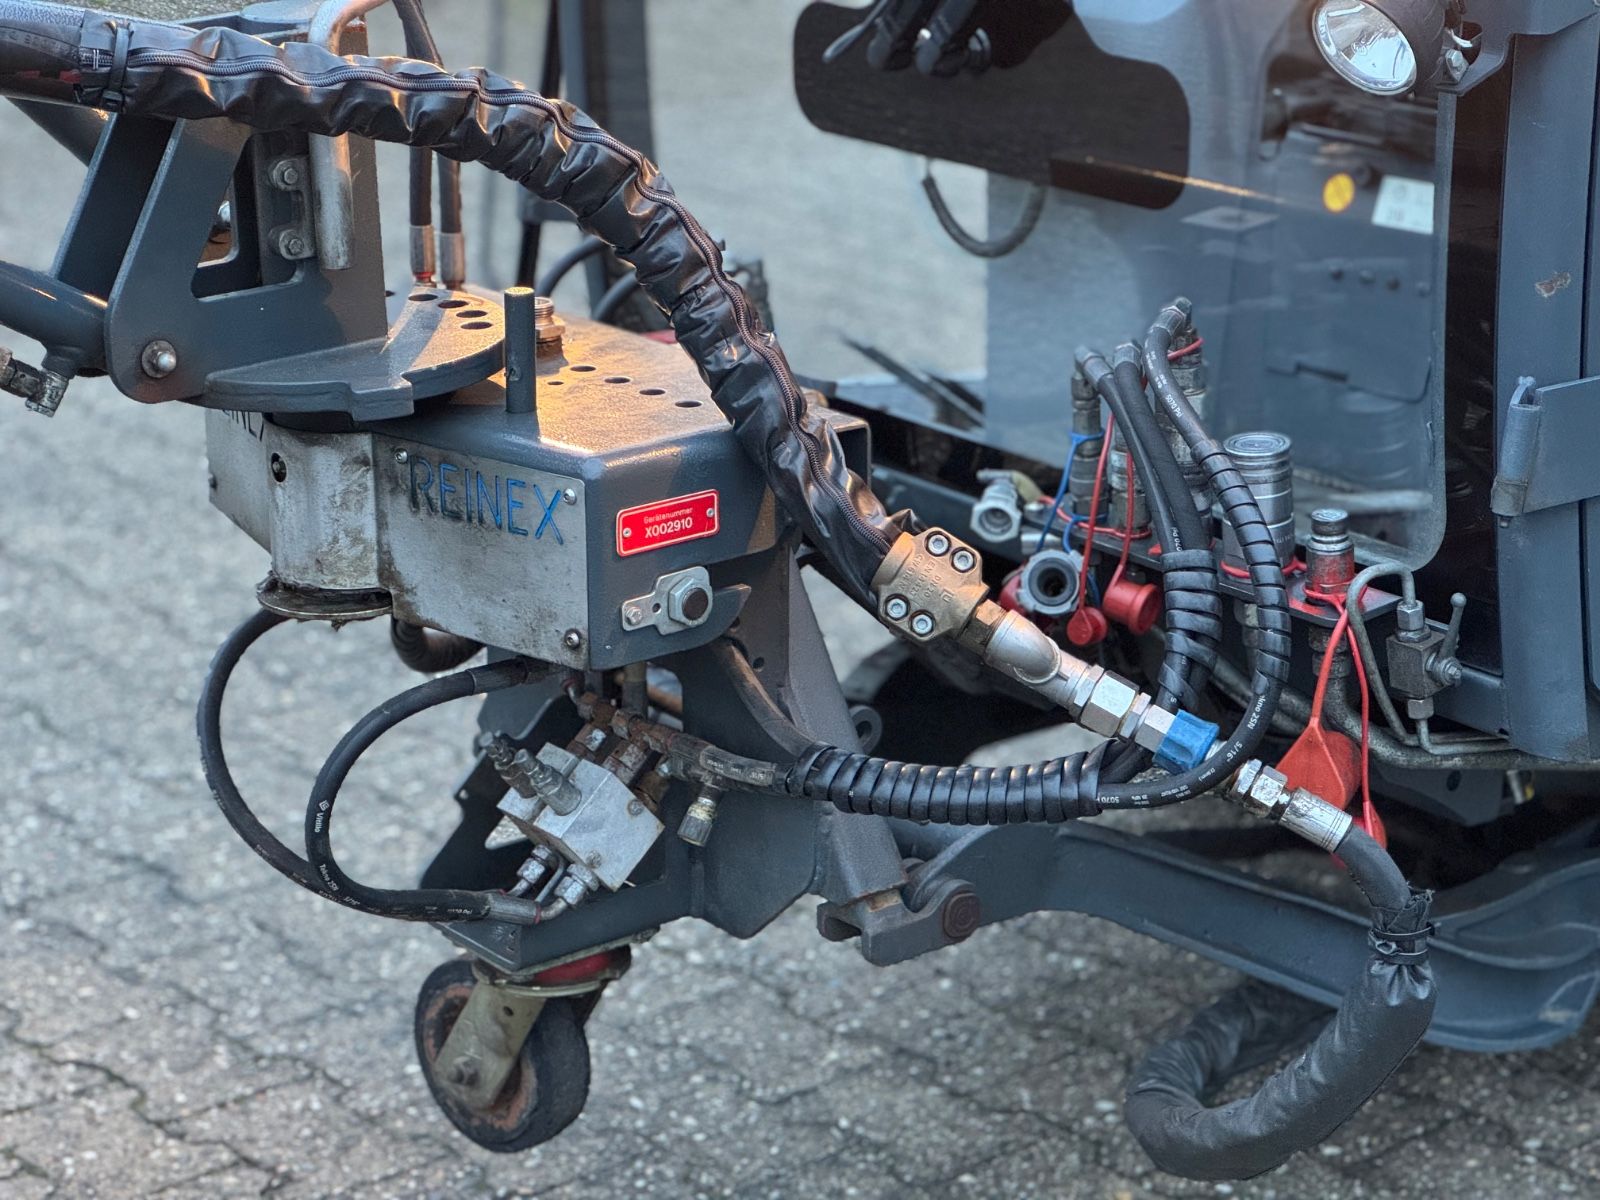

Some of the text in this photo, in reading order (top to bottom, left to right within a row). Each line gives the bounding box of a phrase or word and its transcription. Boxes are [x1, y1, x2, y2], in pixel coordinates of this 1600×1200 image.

[409, 454, 564, 545] REINEX
[643, 507, 693, 524] Gerätenummer
[645, 517, 693, 538] X002910
[1101, 796, 1119, 804] 5070
